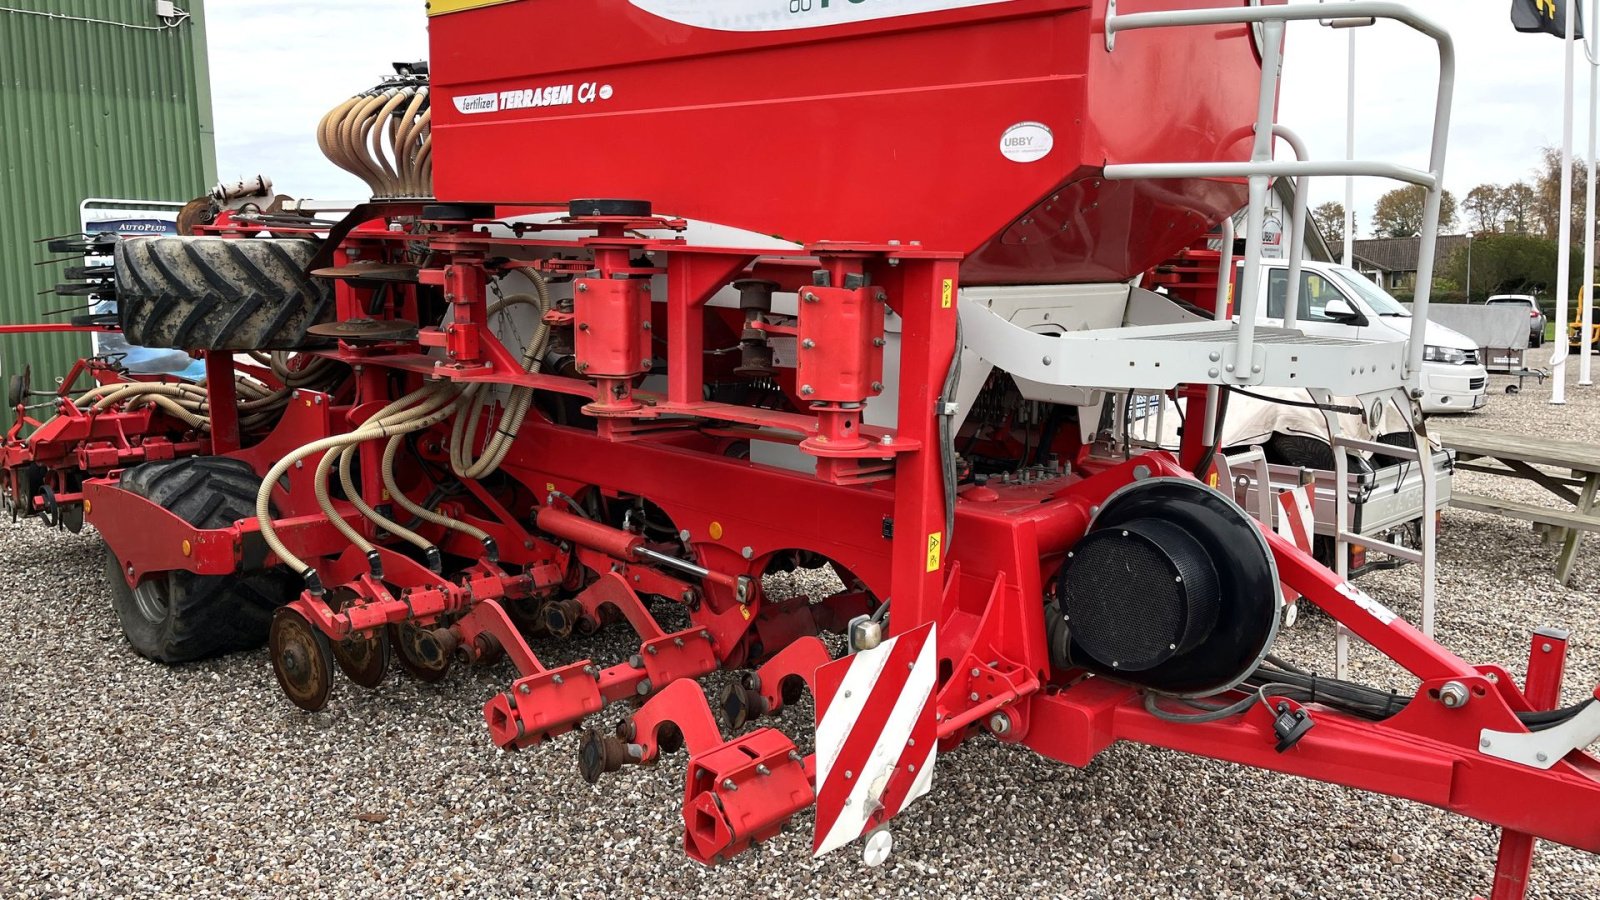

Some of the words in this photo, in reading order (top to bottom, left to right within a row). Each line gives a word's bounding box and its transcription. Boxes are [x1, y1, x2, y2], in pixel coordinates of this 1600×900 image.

[462, 98, 495, 110] fertilizer
[500, 85, 573, 110] TERRASEM
[577, 82, 597, 104] C4
[1004, 136, 1033, 147] UBBY
